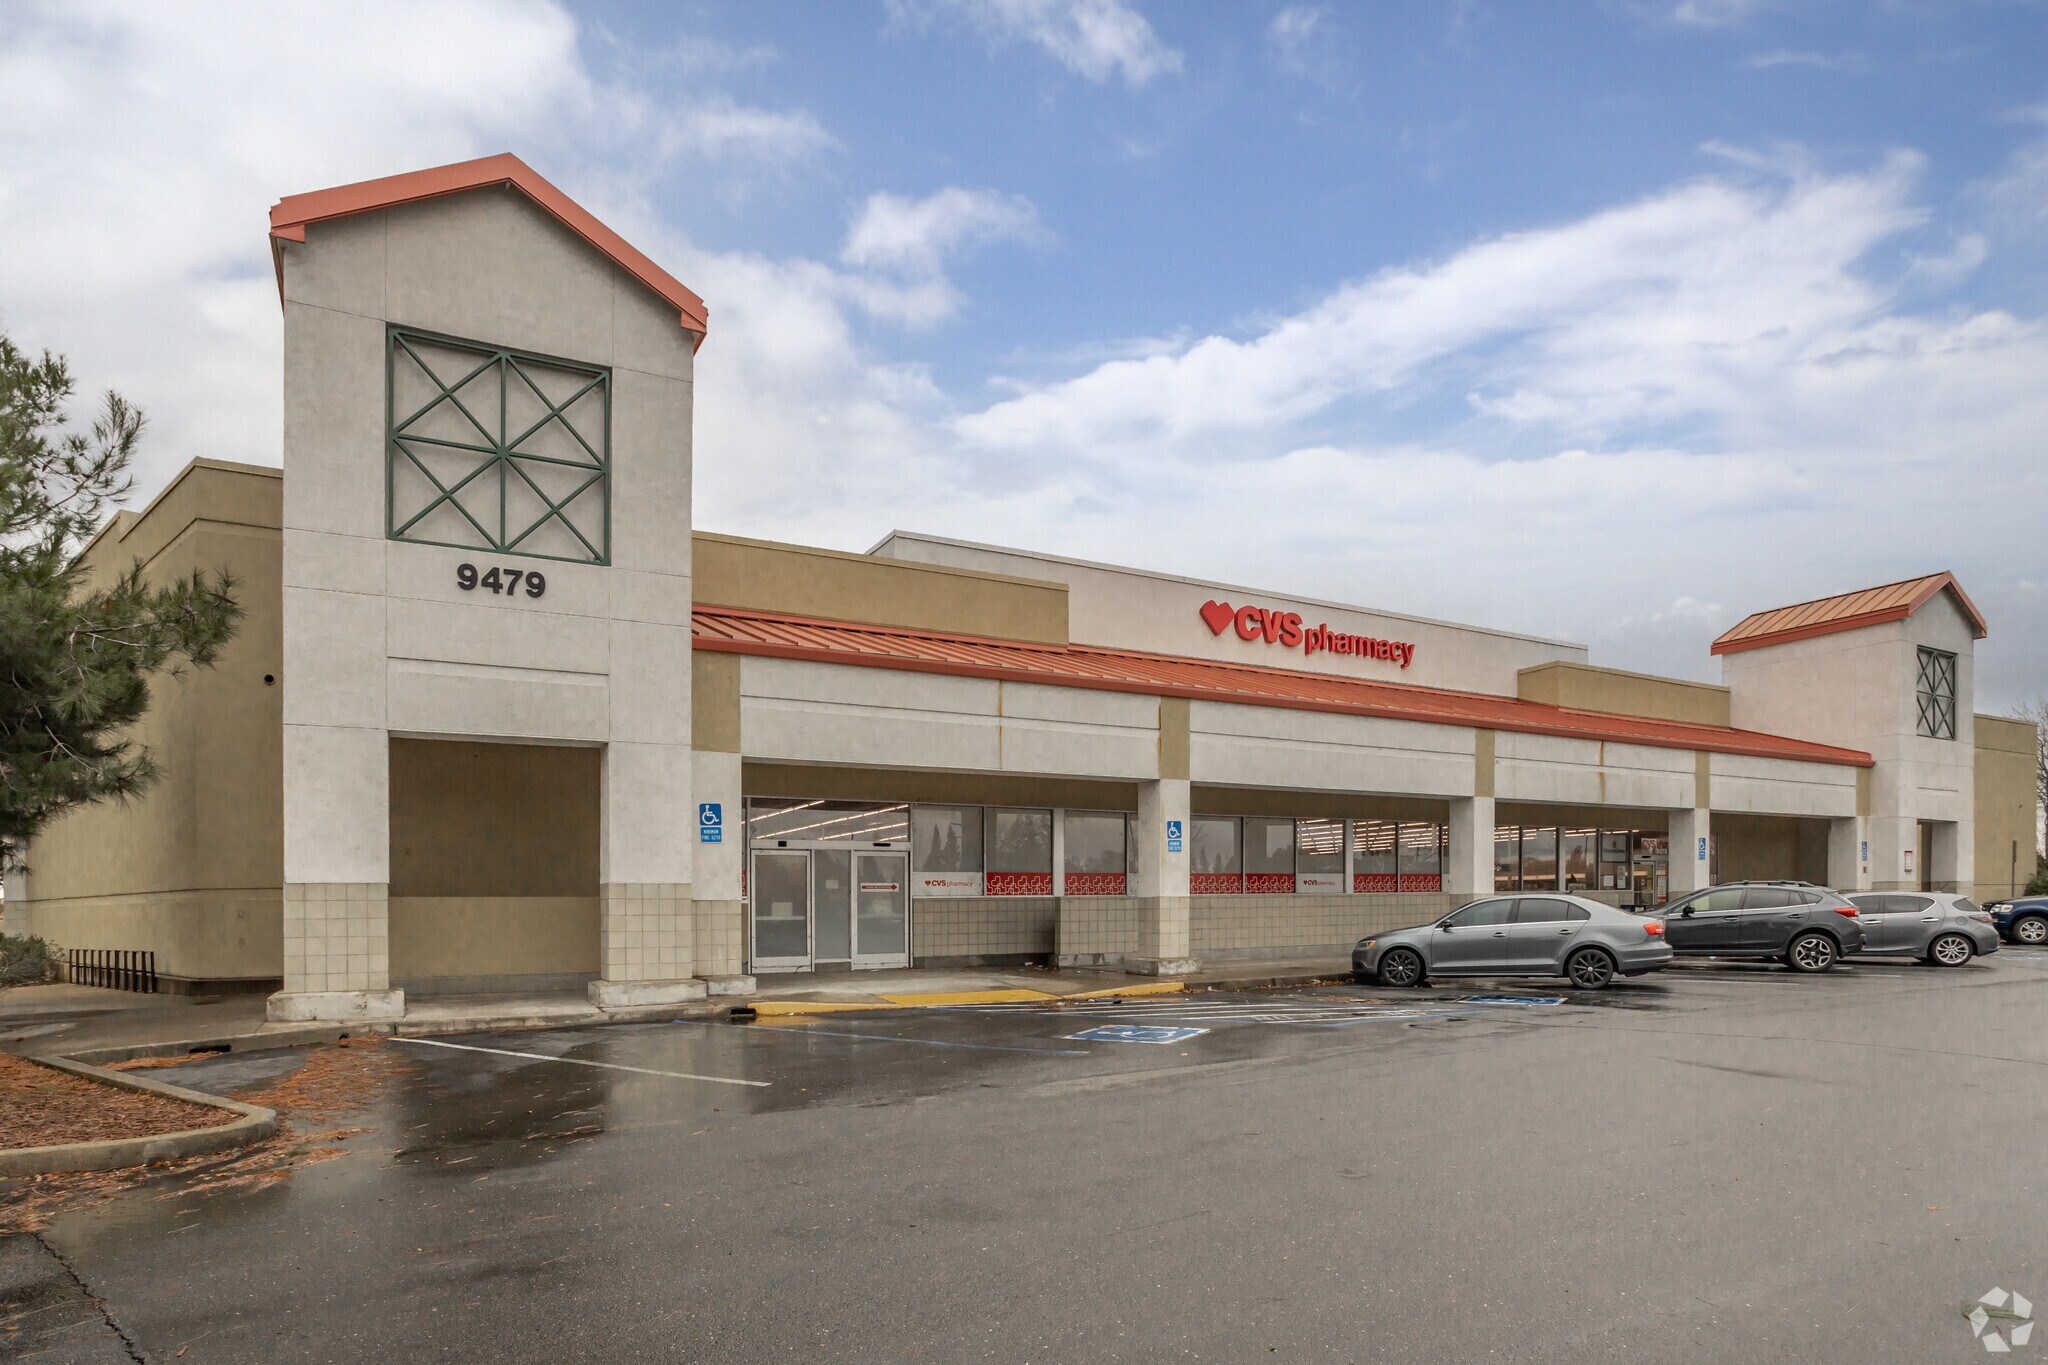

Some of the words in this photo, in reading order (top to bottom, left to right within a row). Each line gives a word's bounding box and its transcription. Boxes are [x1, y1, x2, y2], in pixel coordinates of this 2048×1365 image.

[457, 563, 546, 598] 9479
[1233, 605, 1304, 647] CVS
[1304, 623, 1416, 669] pharmacy
